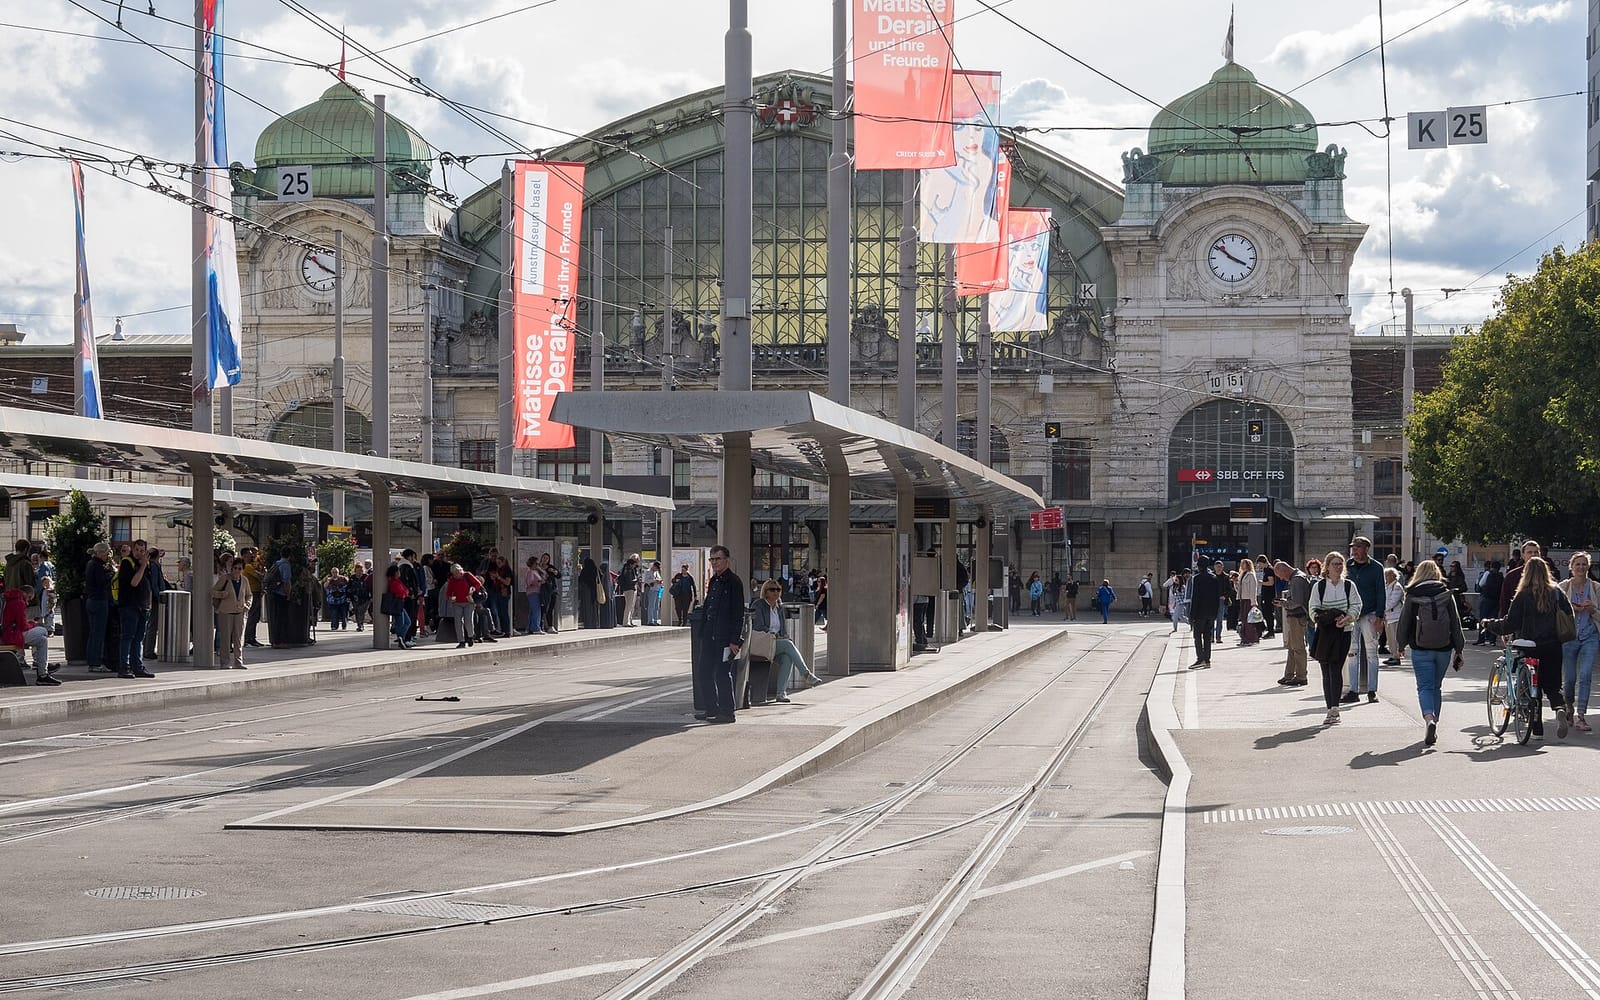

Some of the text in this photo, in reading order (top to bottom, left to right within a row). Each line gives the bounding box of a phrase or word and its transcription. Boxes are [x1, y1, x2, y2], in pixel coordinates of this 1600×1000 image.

[878, 15, 945, 35] Derain
[868, 38, 926, 52] und ihre
[883, 54, 939, 68] Freunde
[1418, 118, 1436, 142] K
[1452, 113, 1483, 138] 25
[282, 172, 309, 195] 25
[527, 179, 542, 285] kunstmuseum basel
[559, 202, 574, 254] Freunde
[557, 257, 571, 281] ihre
[1083, 285, 1094, 298] K
[543, 313, 568, 395] Derain
[1107, 358, 1117, 368] K
[521, 334, 544, 436] Matisse
[1216, 470, 1285, 480] SBB CFF FFS
